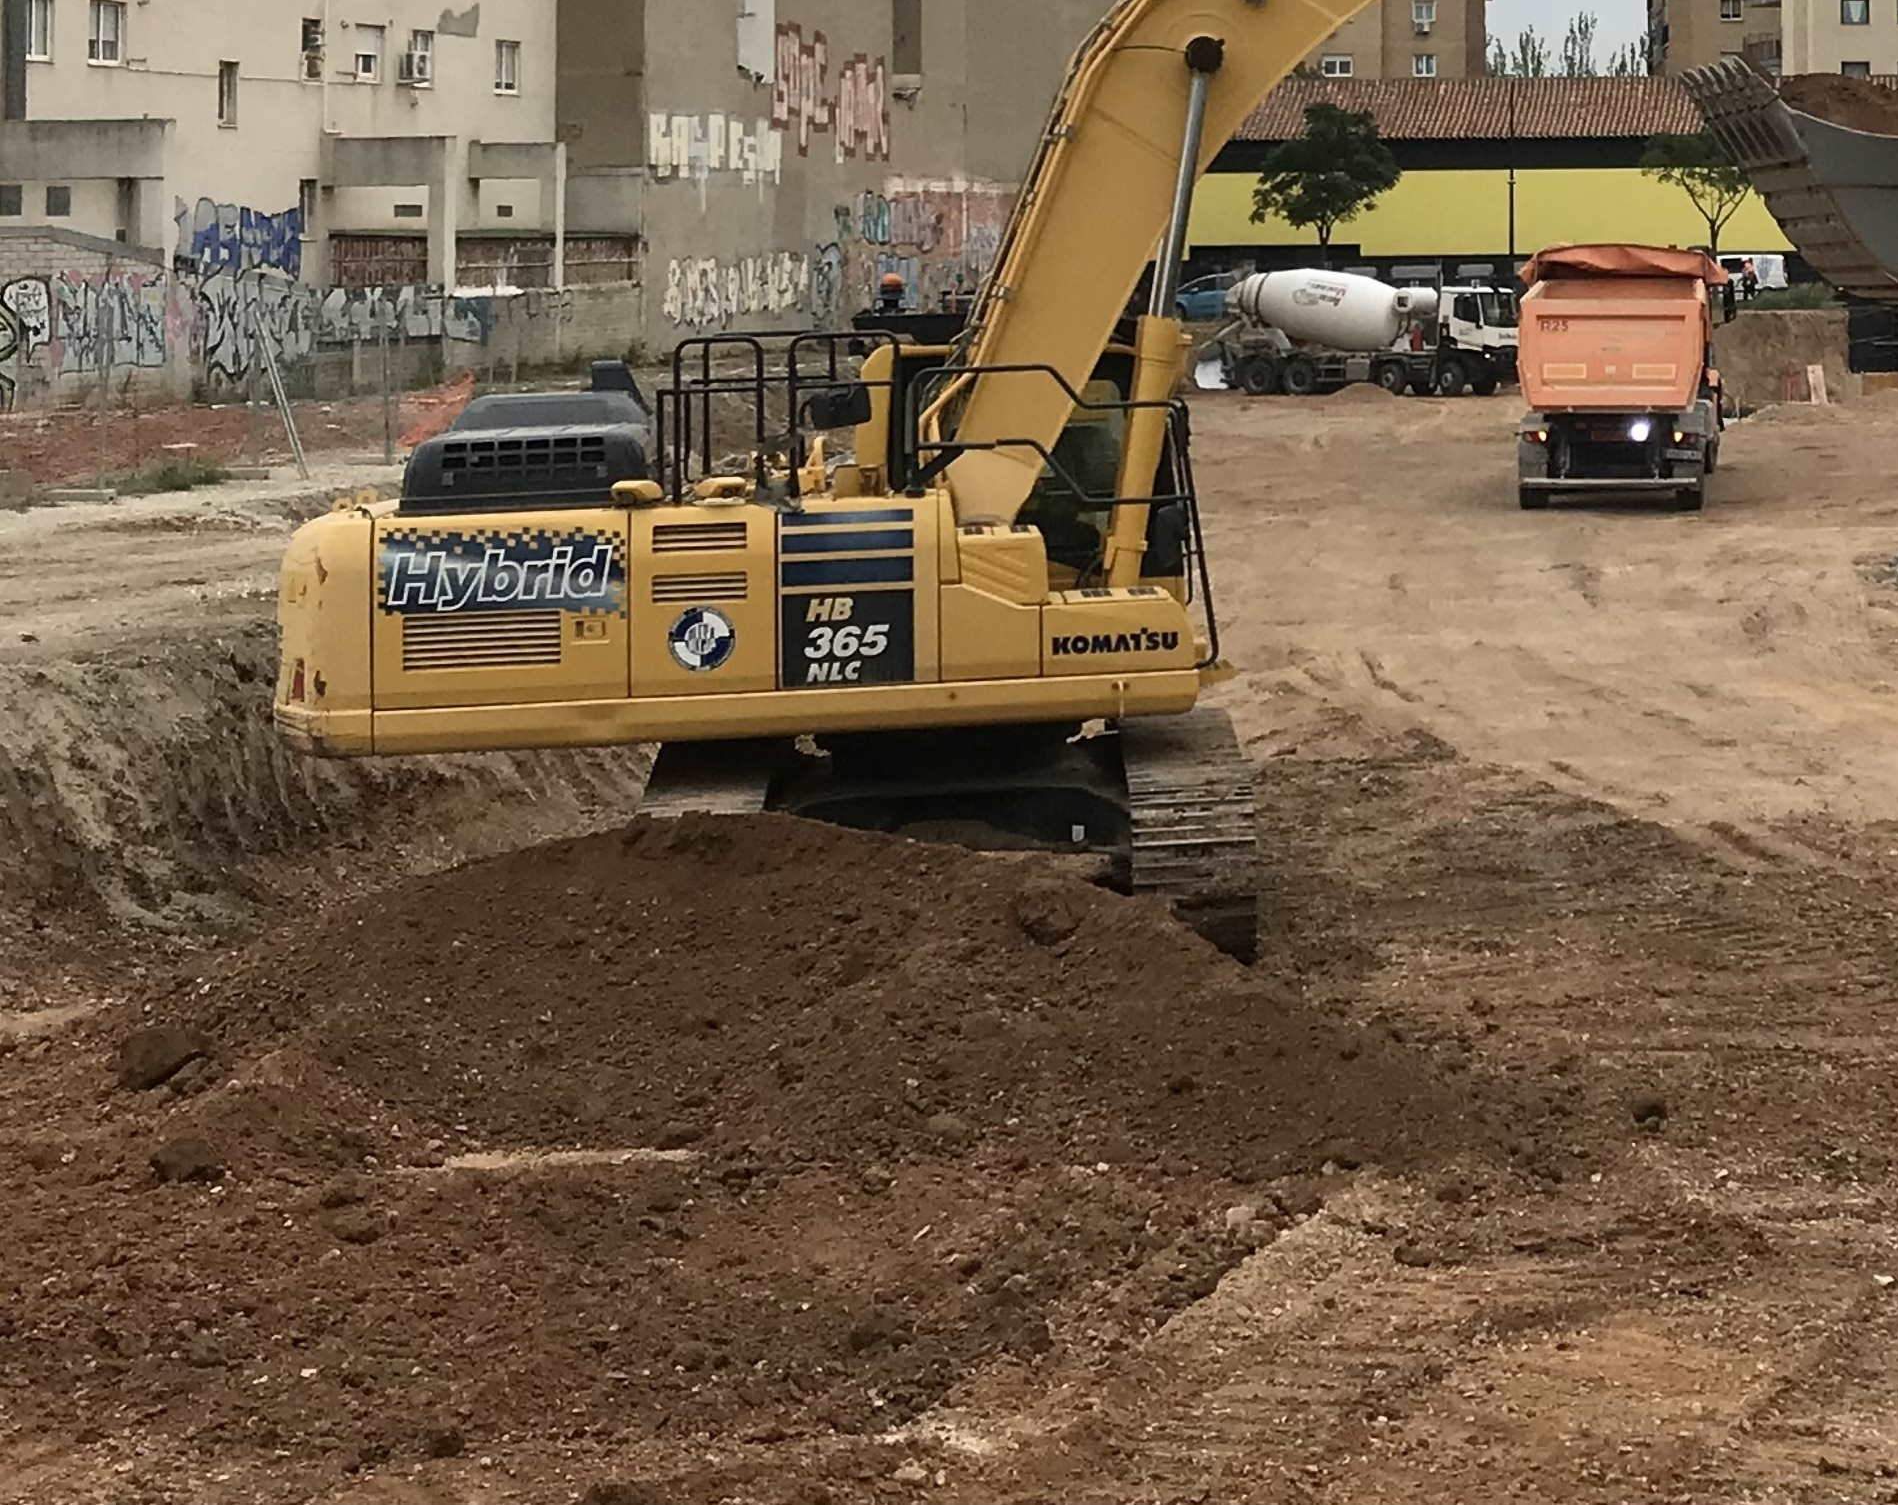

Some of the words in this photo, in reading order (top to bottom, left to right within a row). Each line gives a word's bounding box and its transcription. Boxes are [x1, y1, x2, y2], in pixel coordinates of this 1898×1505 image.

[1540, 319, 1569, 332] R25
[387, 545, 613, 612] Hybrid
[805, 597, 854, 623] HB
[803, 623, 890, 659] 365
[1051, 627, 1179, 656] KOMATSU
[806, 660, 862, 683] NLC
